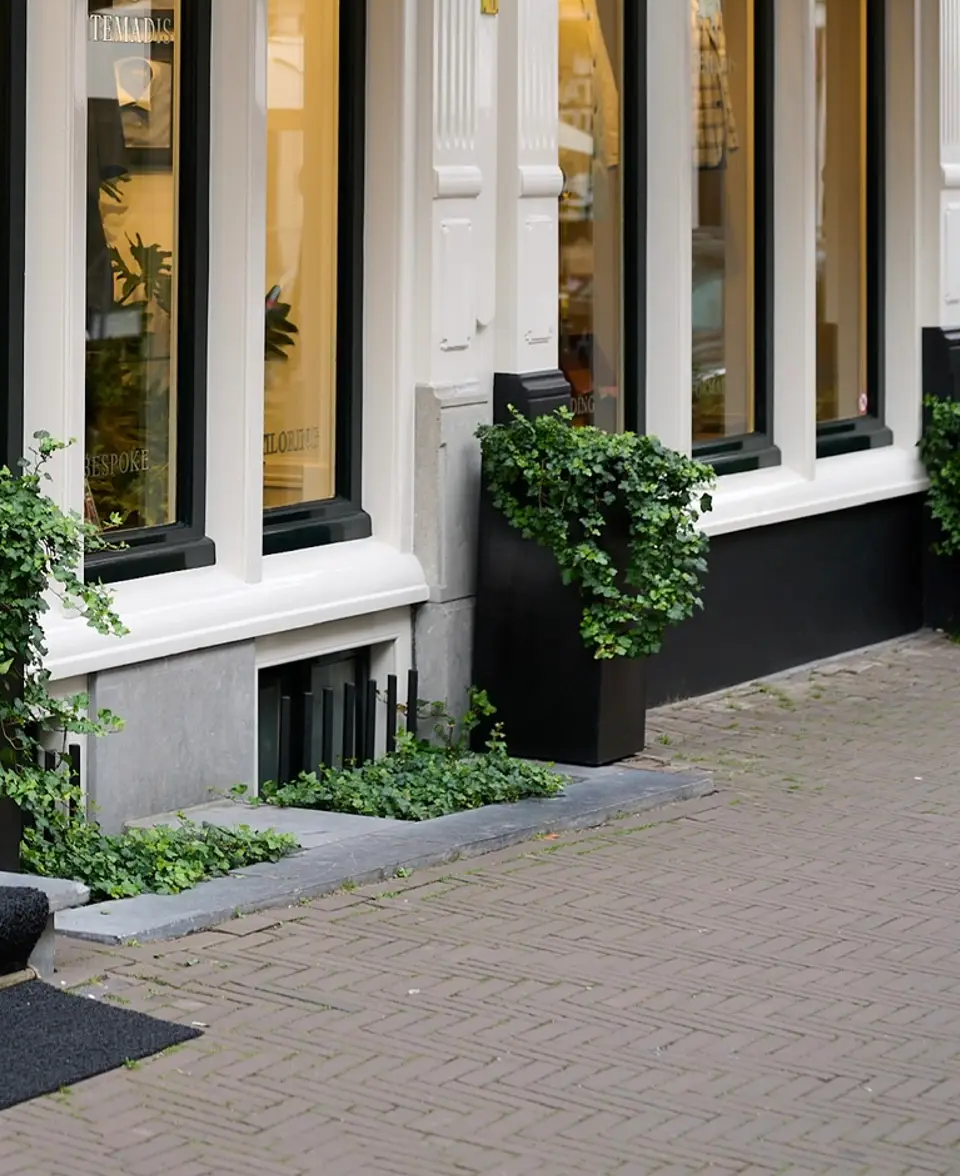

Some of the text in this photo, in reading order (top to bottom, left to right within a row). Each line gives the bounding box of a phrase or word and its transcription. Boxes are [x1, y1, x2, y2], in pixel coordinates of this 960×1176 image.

[90, 13, 173, 44] TEMADIS
[570, 395, 595, 415] DING
[264, 426, 320, 455] ILORING
